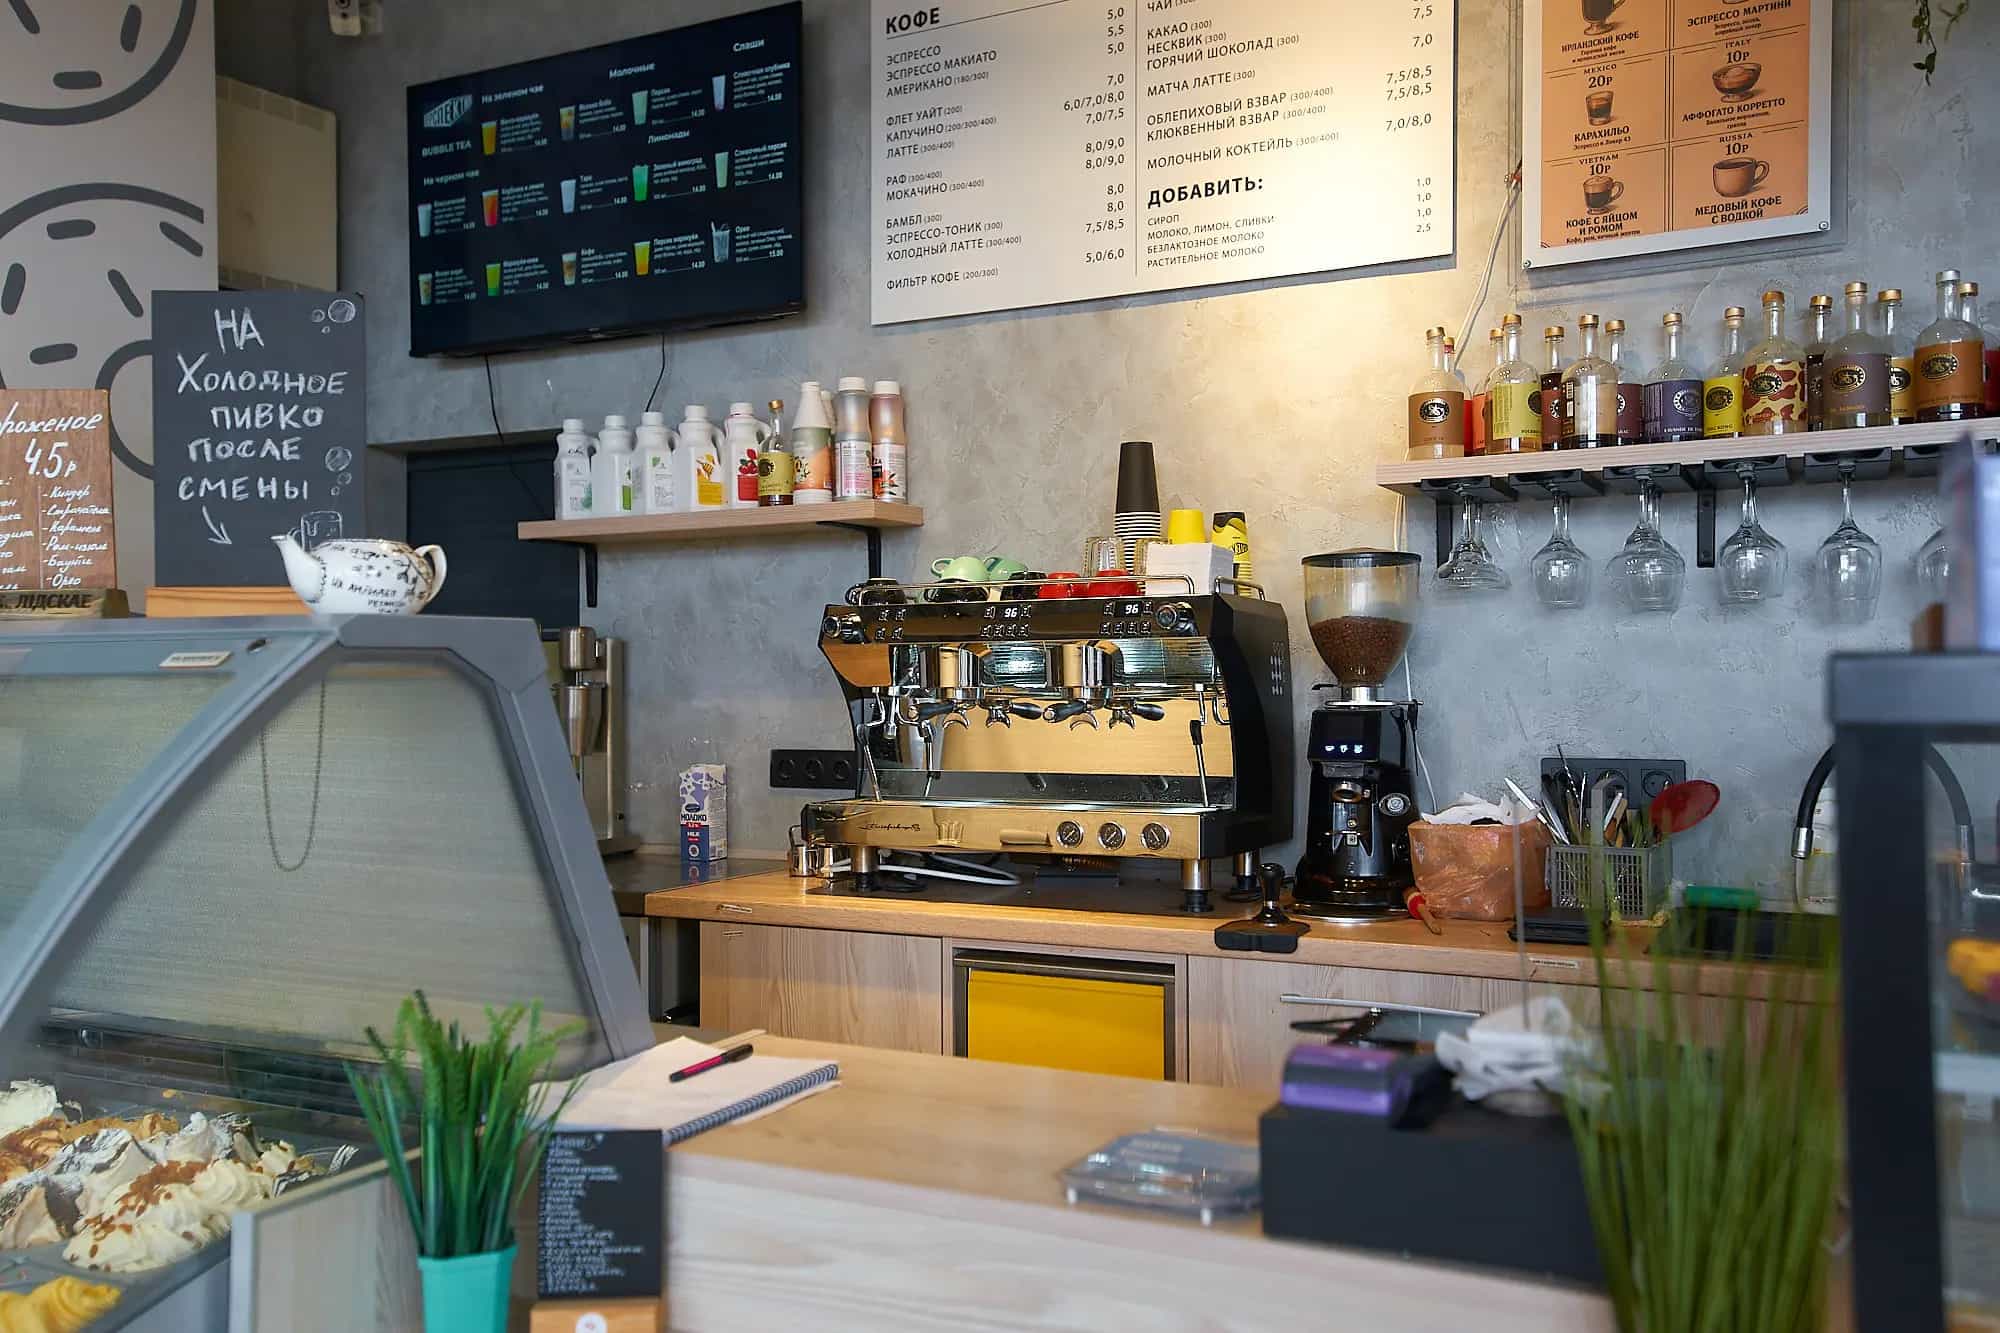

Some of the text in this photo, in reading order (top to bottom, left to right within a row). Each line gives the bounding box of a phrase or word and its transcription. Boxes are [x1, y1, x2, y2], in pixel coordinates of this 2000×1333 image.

[886, 7, 941, 34] КОФЕ
[1688, 9, 1740, 27] ЭСПРЕССО
[1744, 0, 1792, 16] МАРТИНИ
[886, 7, 1125, 66] ЭСПРЕССО 5,0
[1147, 5, 1432, 71] ГОРЯЧИЙ ШОКОЛАД (300) 7,5
[1148, 22, 1188, 39] КАКАО
[1561, 30, 1640, 52] ИРЛАНДСКИЙ КОФЕ
[1726, 38, 1752, 48] ITALY
[733, 39, 764, 52] Слаши
[886, 24, 1125, 82] ЭСПРЕССО МАКИАТО 5,5
[1147, 34, 1202, 56] НЕСКВИК
[609, 62, 656, 80] Молочные
[886, 42, 1125, 98] АМЕРИКАНО 5,0
[1147, 33, 1432, 97] МАТЧА ЛАТТЕ (300) 7,0
[1584, 64, 1616, 74] MEXICO
[482, 95, 492, 104] На
[494, 87, 528, 101] зеленом
[886, 112, 914, 127] ФЛЕТ
[916, 107, 944, 122] УАЙТ
[1107, 72, 1125, 86] 7,0
[1147, 98, 1242, 126] ОБЛЕПИХОВЫЙ
[1247, 92, 1287, 110] ВЗВАР
[1386, 65, 1432, 85] 7,5/8,5
[886, 124, 944, 143] КАПУЧИНО
[1064, 91, 1125, 112] 6,0/7,0/8,0
[1147, 116, 1235, 142] КЛЮКВЕННЫЙ
[1240, 110, 1279, 128] ВЗВАР
[1386, 82, 1432, 102] 7,5/8,5
[1682, 106, 1734, 122] АФФОГАТО
[1737, 98, 1786, 113] КОРРЕТТО
[454, 139, 472, 151] TEA
[648, 130, 690, 144] Лимонады
[886, 145, 919, 159] ЛАТТЕ
[1086, 108, 1124, 125] 7,0/7,5
[1147, 146, 1222, 170] МОЛОЧНЫЙ
[1226, 137, 1293, 158] КОКТЕЙЛЬ
[1386, 113, 1432, 132] 7,0/8,0
[1574, 126, 1630, 142] КАРАХИЛЬО
[1720, 132, 1753, 143] RUSSIA
[886, 174, 907, 186] РАФ
[1086, 137, 1125, 154] 8,0/9,0
[1579, 154, 1618, 165] VIETNAM
[886, 182, 948, 201] МОКАЧИНО
[1086, 154, 1125, 170] 8,0/9,0
[1147, 176, 1264, 208] ДОБАВИТЬ:
[1147, 177, 1431, 226] СИРОП 1,0
[886, 216, 922, 229] БАМБЛ
[1107, 184, 1125, 196] 8,0
[1147, 226, 1192, 241] МОЛОКО,
[1234, 215, 1274, 230] СЛИВКИ
[1416, 192, 1431, 203] 1,0
[1695, 196, 1782, 216] МЕДОВЫЙ КОФЕ
[1712, 208, 1763, 224] С ВОДКОЙ
[887, 222, 982, 245] ЭСПРЕССО-ТОНИК
[1107, 201, 1125, 213] 8,0
[1147, 207, 1431, 255] БЕЗЛАКТОЗНОЕ МОЛОКО 1,0
[1566, 211, 1638, 229] КОФЕ С ЯЙЦОМ
[1580, 226, 1586, 236] И
[1589, 222, 1623, 234] РОМОМ
[887, 242, 947, 262] ХОЛОДНЫЙ
[950, 238, 984, 253] ЛАТТЕ
[1086, 218, 1124, 234] 7,5/8,5
[886, 275, 928, 290] ФИЛЬТР
[931, 271, 960, 286] КОФЕ
[1086, 248, 1125, 264] 5,0/6,0
[1147, 251, 1219, 269] РАСТИТЕЛЬНОЕ
[1222, 245, 1265, 259] МОЛОКО
[214, 306, 264, 355] НА
[210, 403, 324, 430] ПИВКО
[188, 437, 303, 464] ПОСЛЕ
[178, 476, 308, 501] СМЕНЫ
[1004, 608, 1018, 618] 96
[1125, 605, 1138, 614] 96
